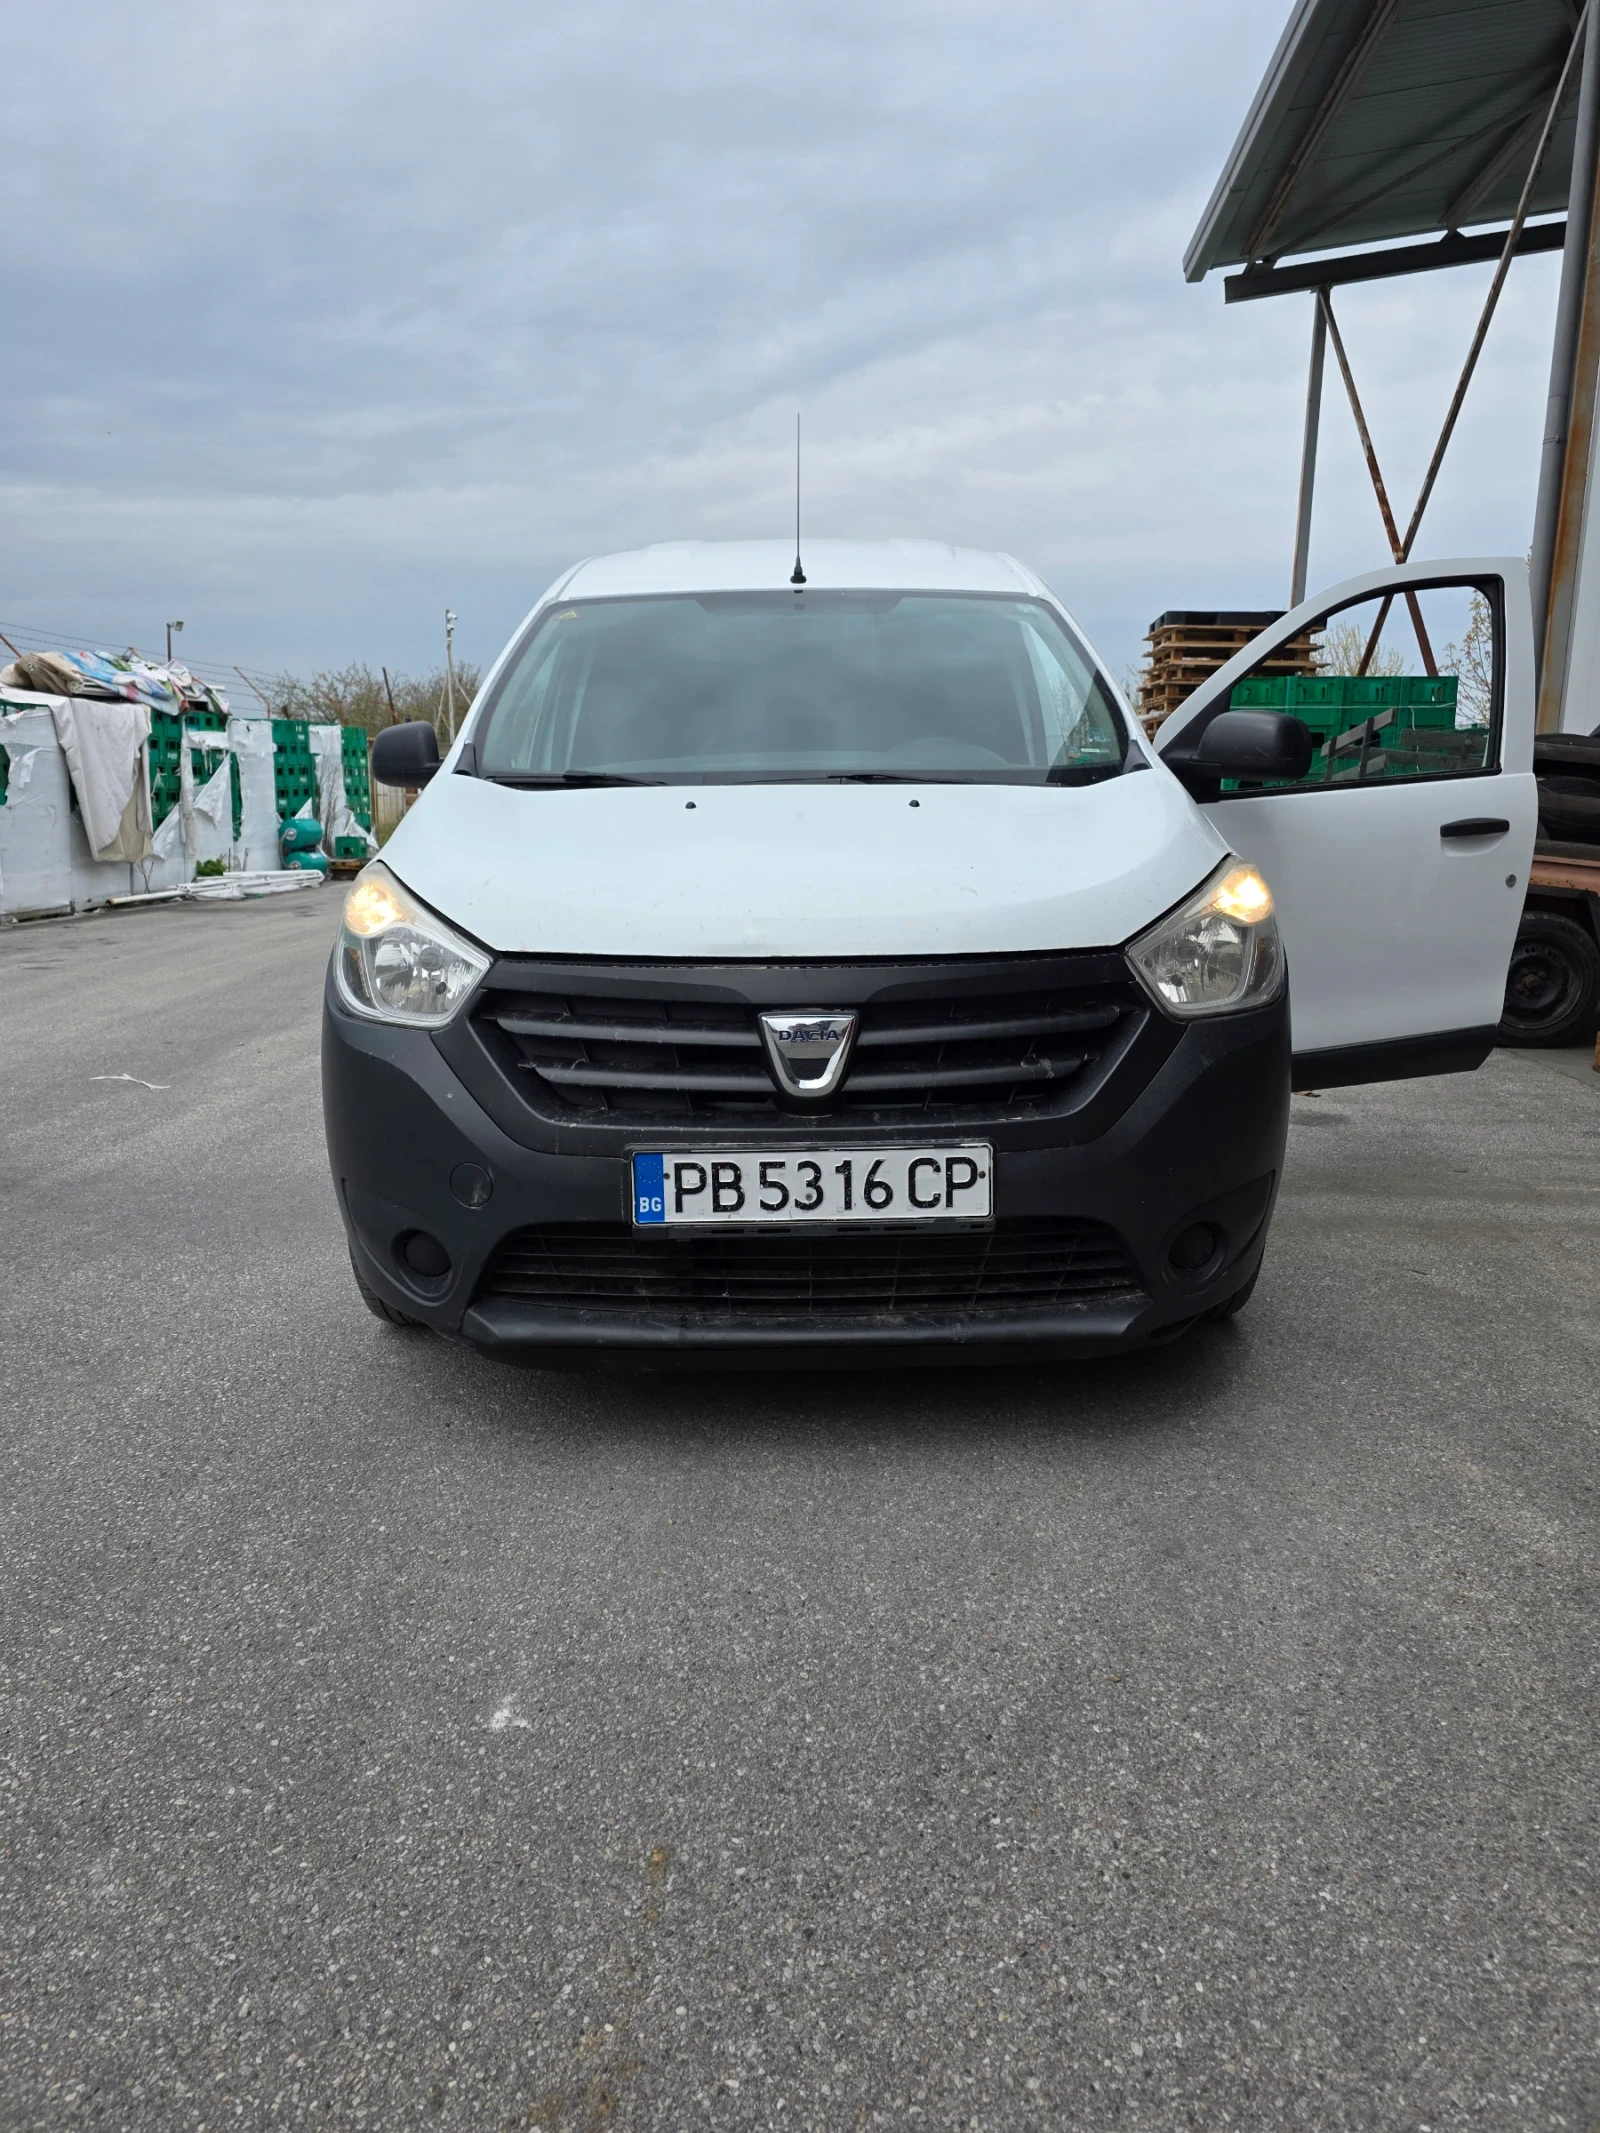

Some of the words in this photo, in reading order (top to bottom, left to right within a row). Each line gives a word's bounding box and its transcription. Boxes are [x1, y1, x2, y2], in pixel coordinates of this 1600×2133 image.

[779, 1030, 840, 1042] DACIA
[673, 1161, 746, 1214] PB
[759, 1158, 894, 1212] 5316
[908, 1156, 979, 1210] CP
[639, 1197, 662, 1213] BG
